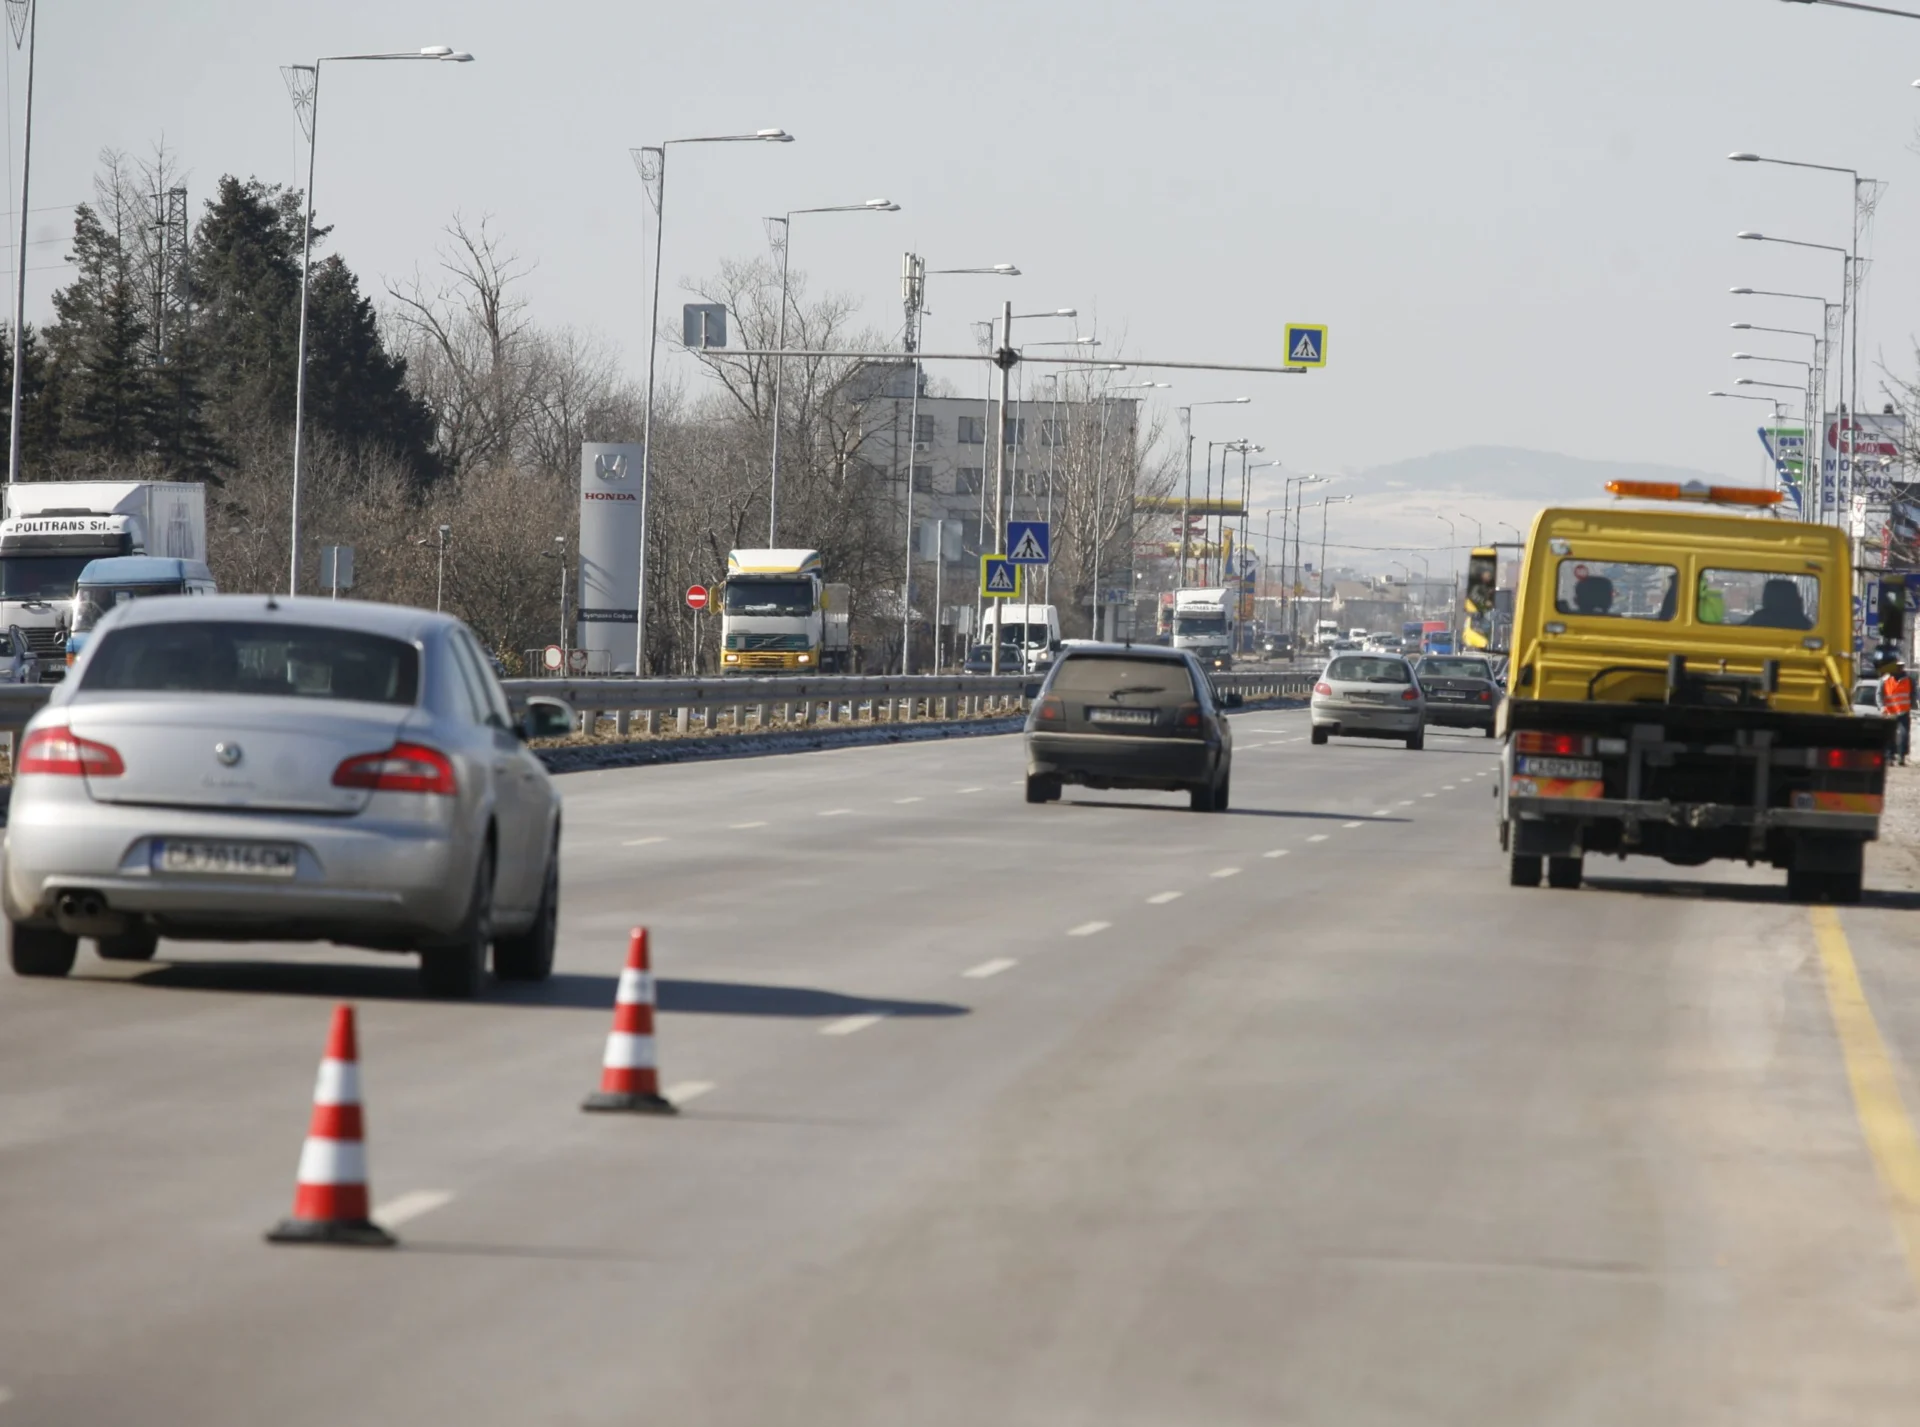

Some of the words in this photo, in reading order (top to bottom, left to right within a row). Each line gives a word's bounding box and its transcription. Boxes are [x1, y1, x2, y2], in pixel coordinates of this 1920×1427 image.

[584, 492, 637, 501] HONDA
[15, 521, 85, 533] POLITRANS
[90, 520, 110, 531] Srl.
